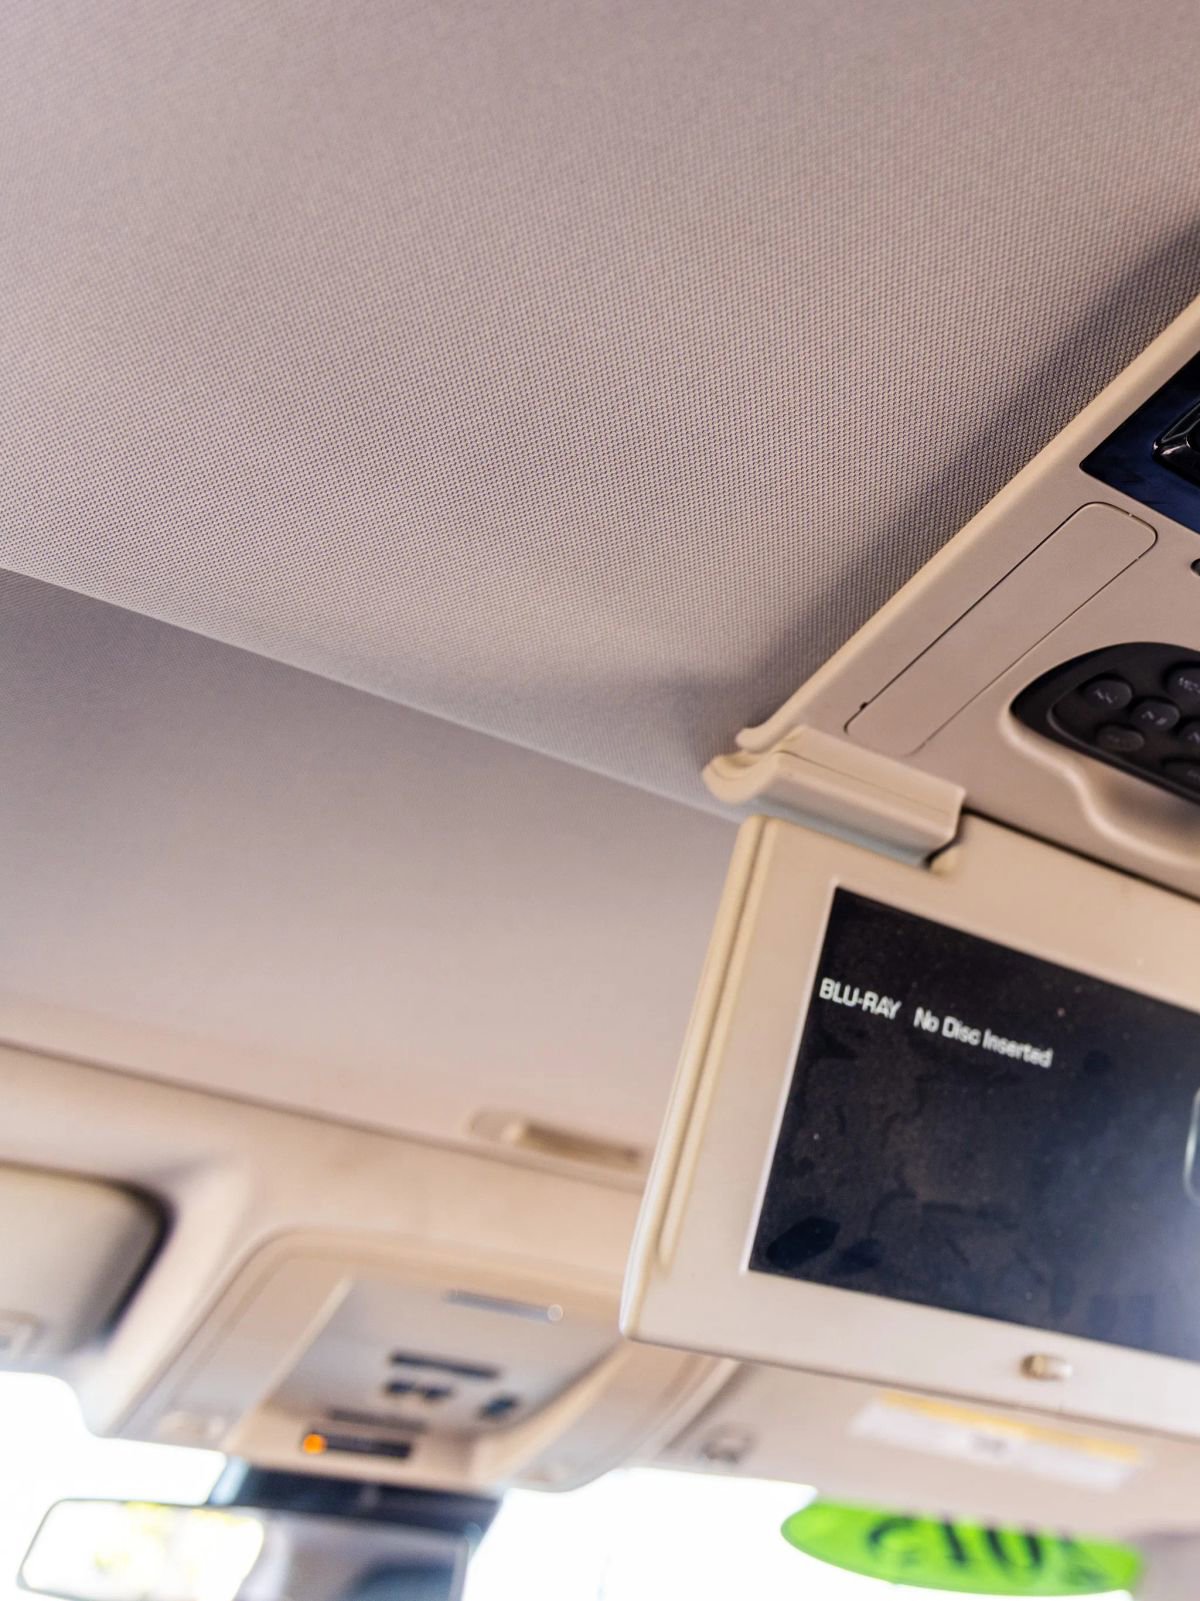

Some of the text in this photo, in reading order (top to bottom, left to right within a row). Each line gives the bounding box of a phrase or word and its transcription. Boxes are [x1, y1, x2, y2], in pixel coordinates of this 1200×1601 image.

[819, 977, 1054, 1068] BLU-RAY No Disc Inserted
